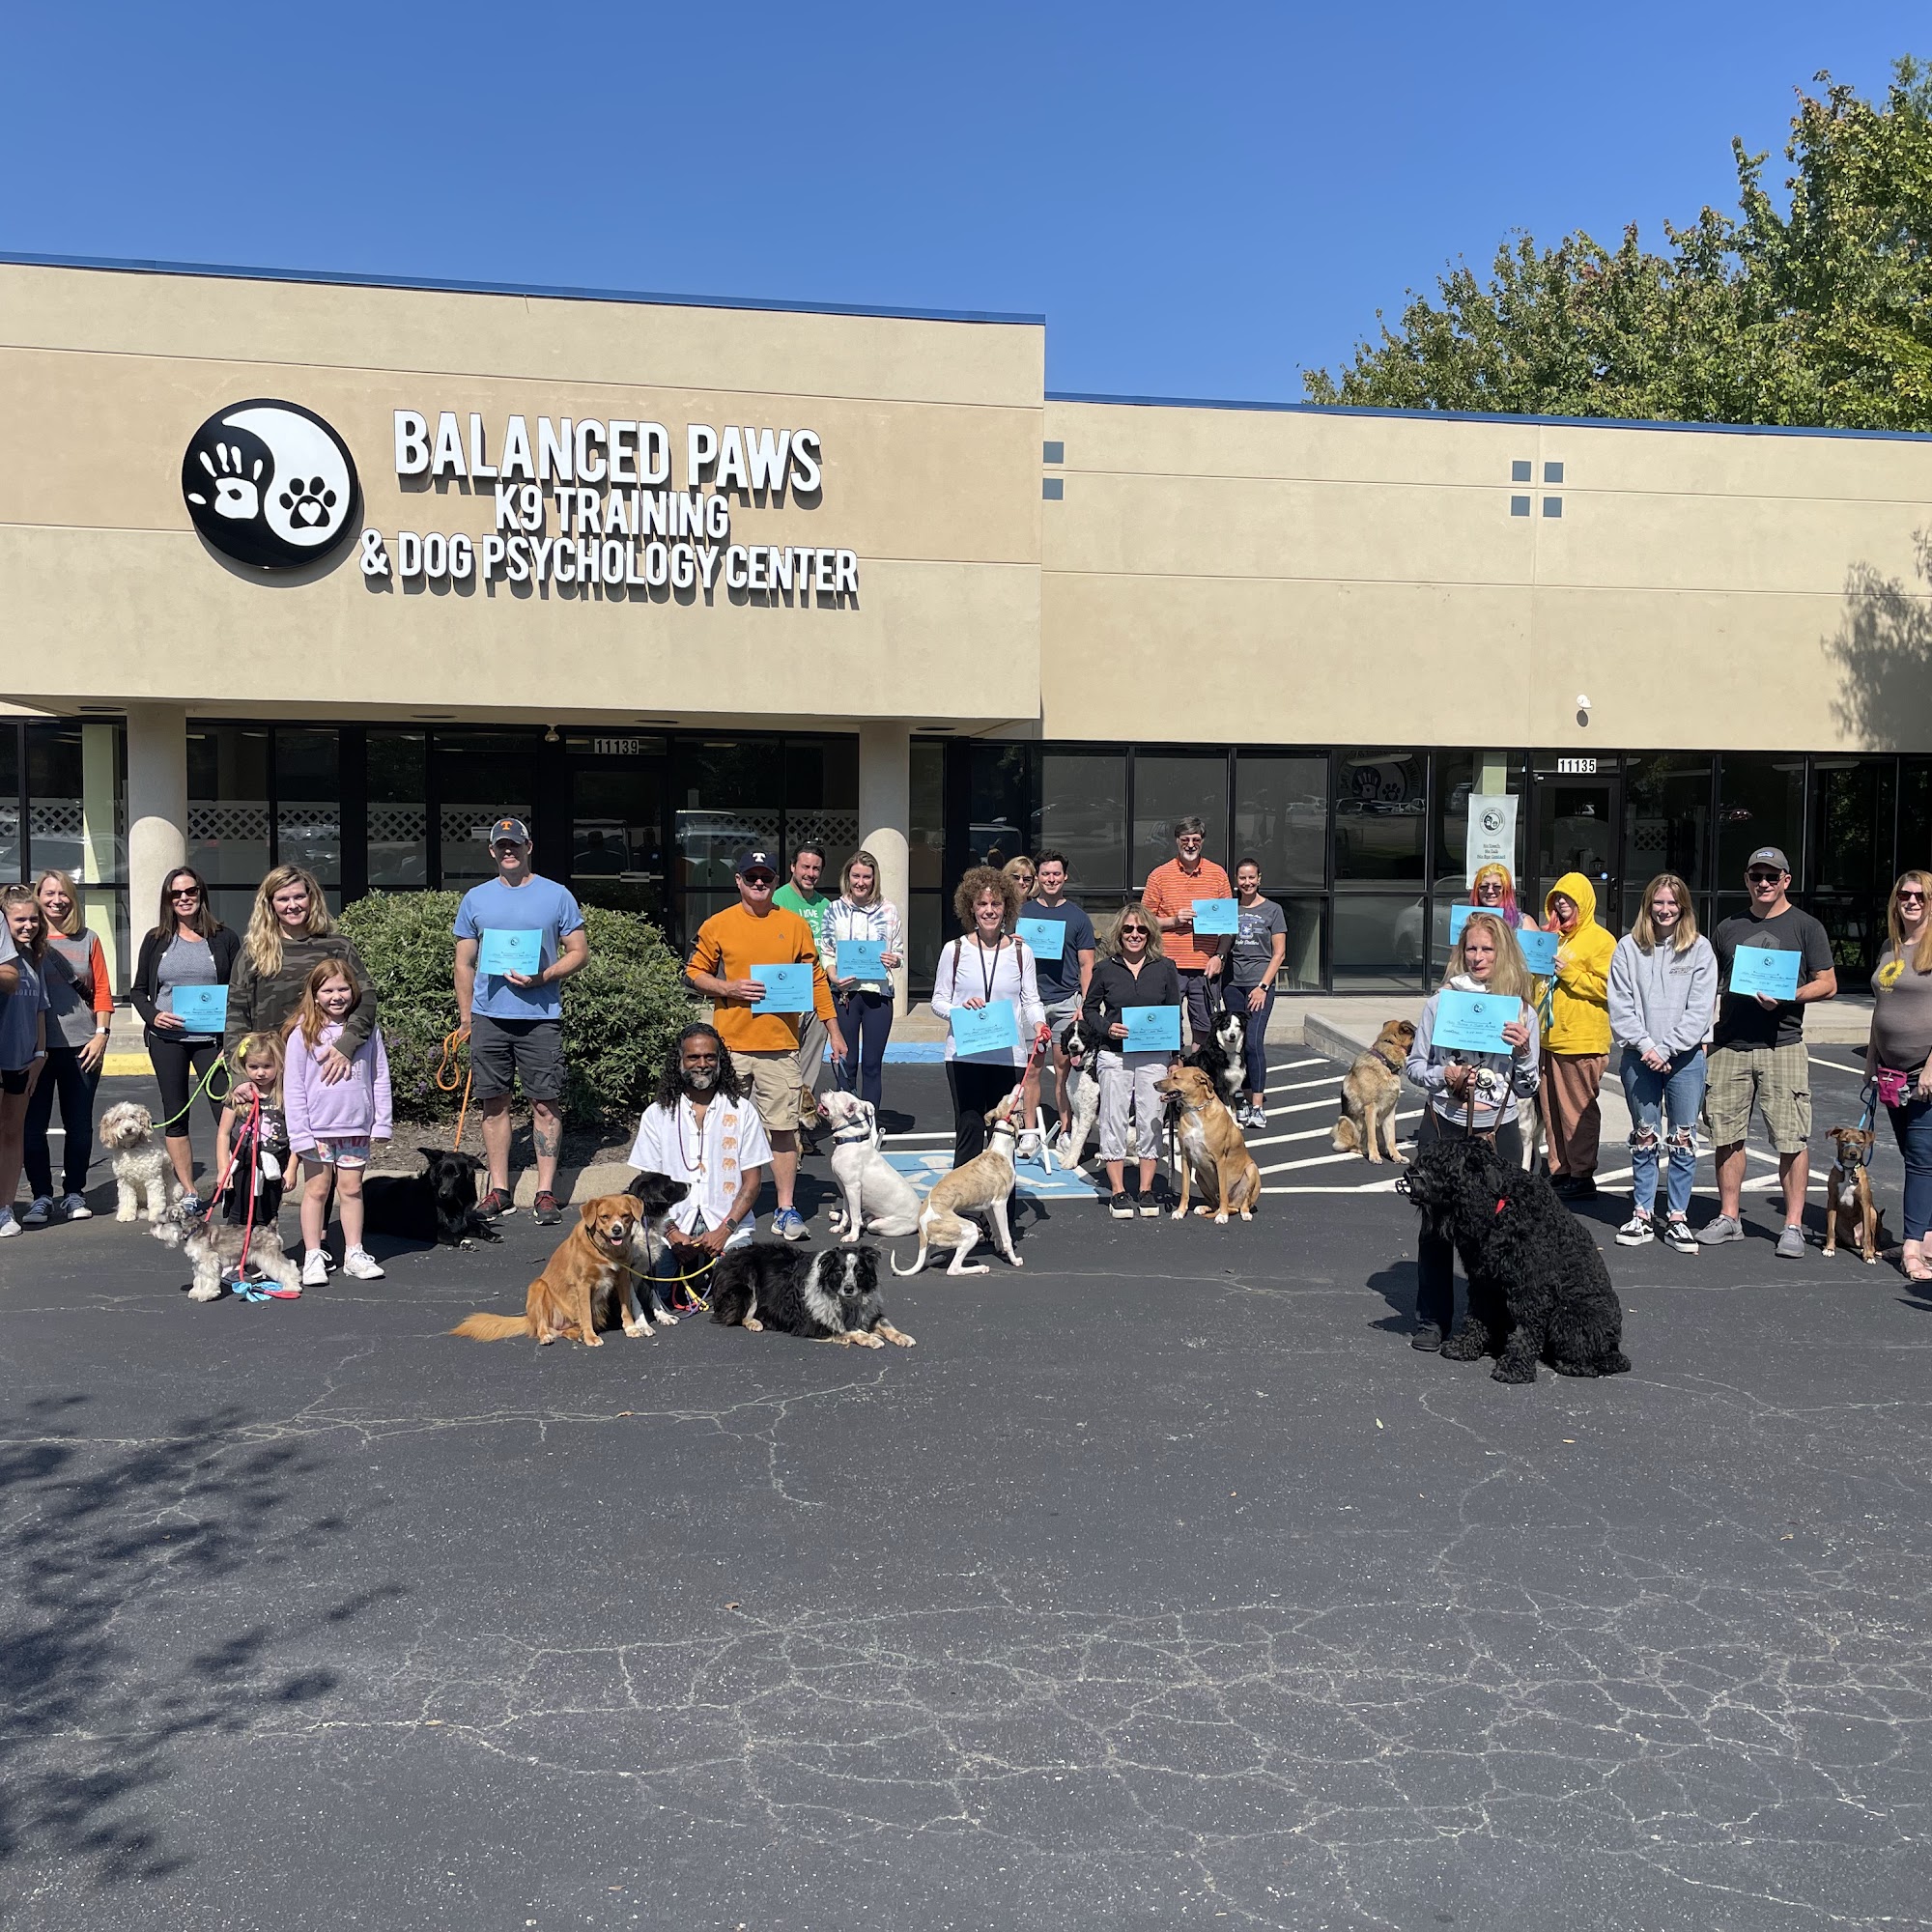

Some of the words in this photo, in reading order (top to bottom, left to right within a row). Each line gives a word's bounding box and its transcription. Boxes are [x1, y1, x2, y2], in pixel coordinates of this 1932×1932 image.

[394, 410, 669, 484] BALANCED
[687, 423, 821, 492] PAWS
[495, 483, 543, 530] K9
[554, 486, 728, 538] TRAINING
[359, 527, 388, 575] &
[398, 531, 472, 579] DOG
[482, 533, 720, 588] PSYCHOLOGY
[725, 544, 858, 592] CENTER
[596, 739, 638, 754] 11139
[1559, 758, 1595, 773] 11135
[499, 820, 513, 831] T
[752, 852, 766, 863] T
[803, 908, 819, 918] LOVE
